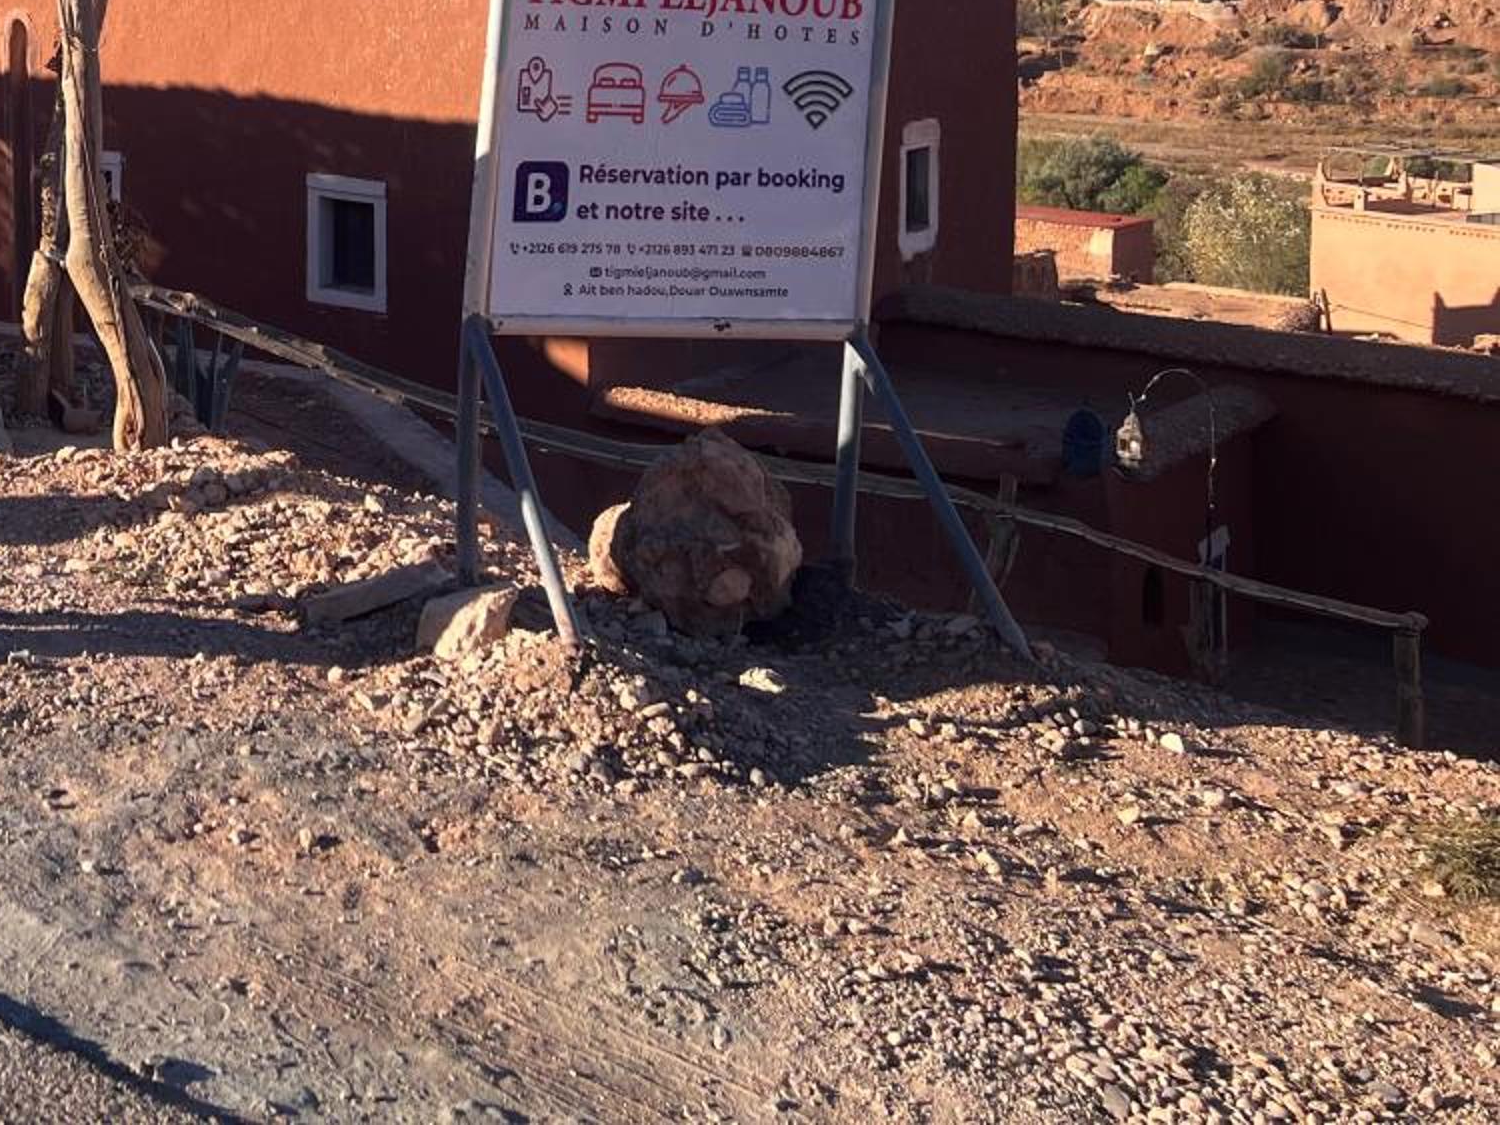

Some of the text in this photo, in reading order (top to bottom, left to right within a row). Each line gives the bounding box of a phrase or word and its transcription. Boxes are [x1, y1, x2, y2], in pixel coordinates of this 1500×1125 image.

[524, 13, 861, 46] MAISON D'HOTES
[579, 164, 845, 193] Réservation par booking
[576, 202, 599, 220] et
[605, 202, 665, 221] notre
[600, 283, 625, 296] ben
